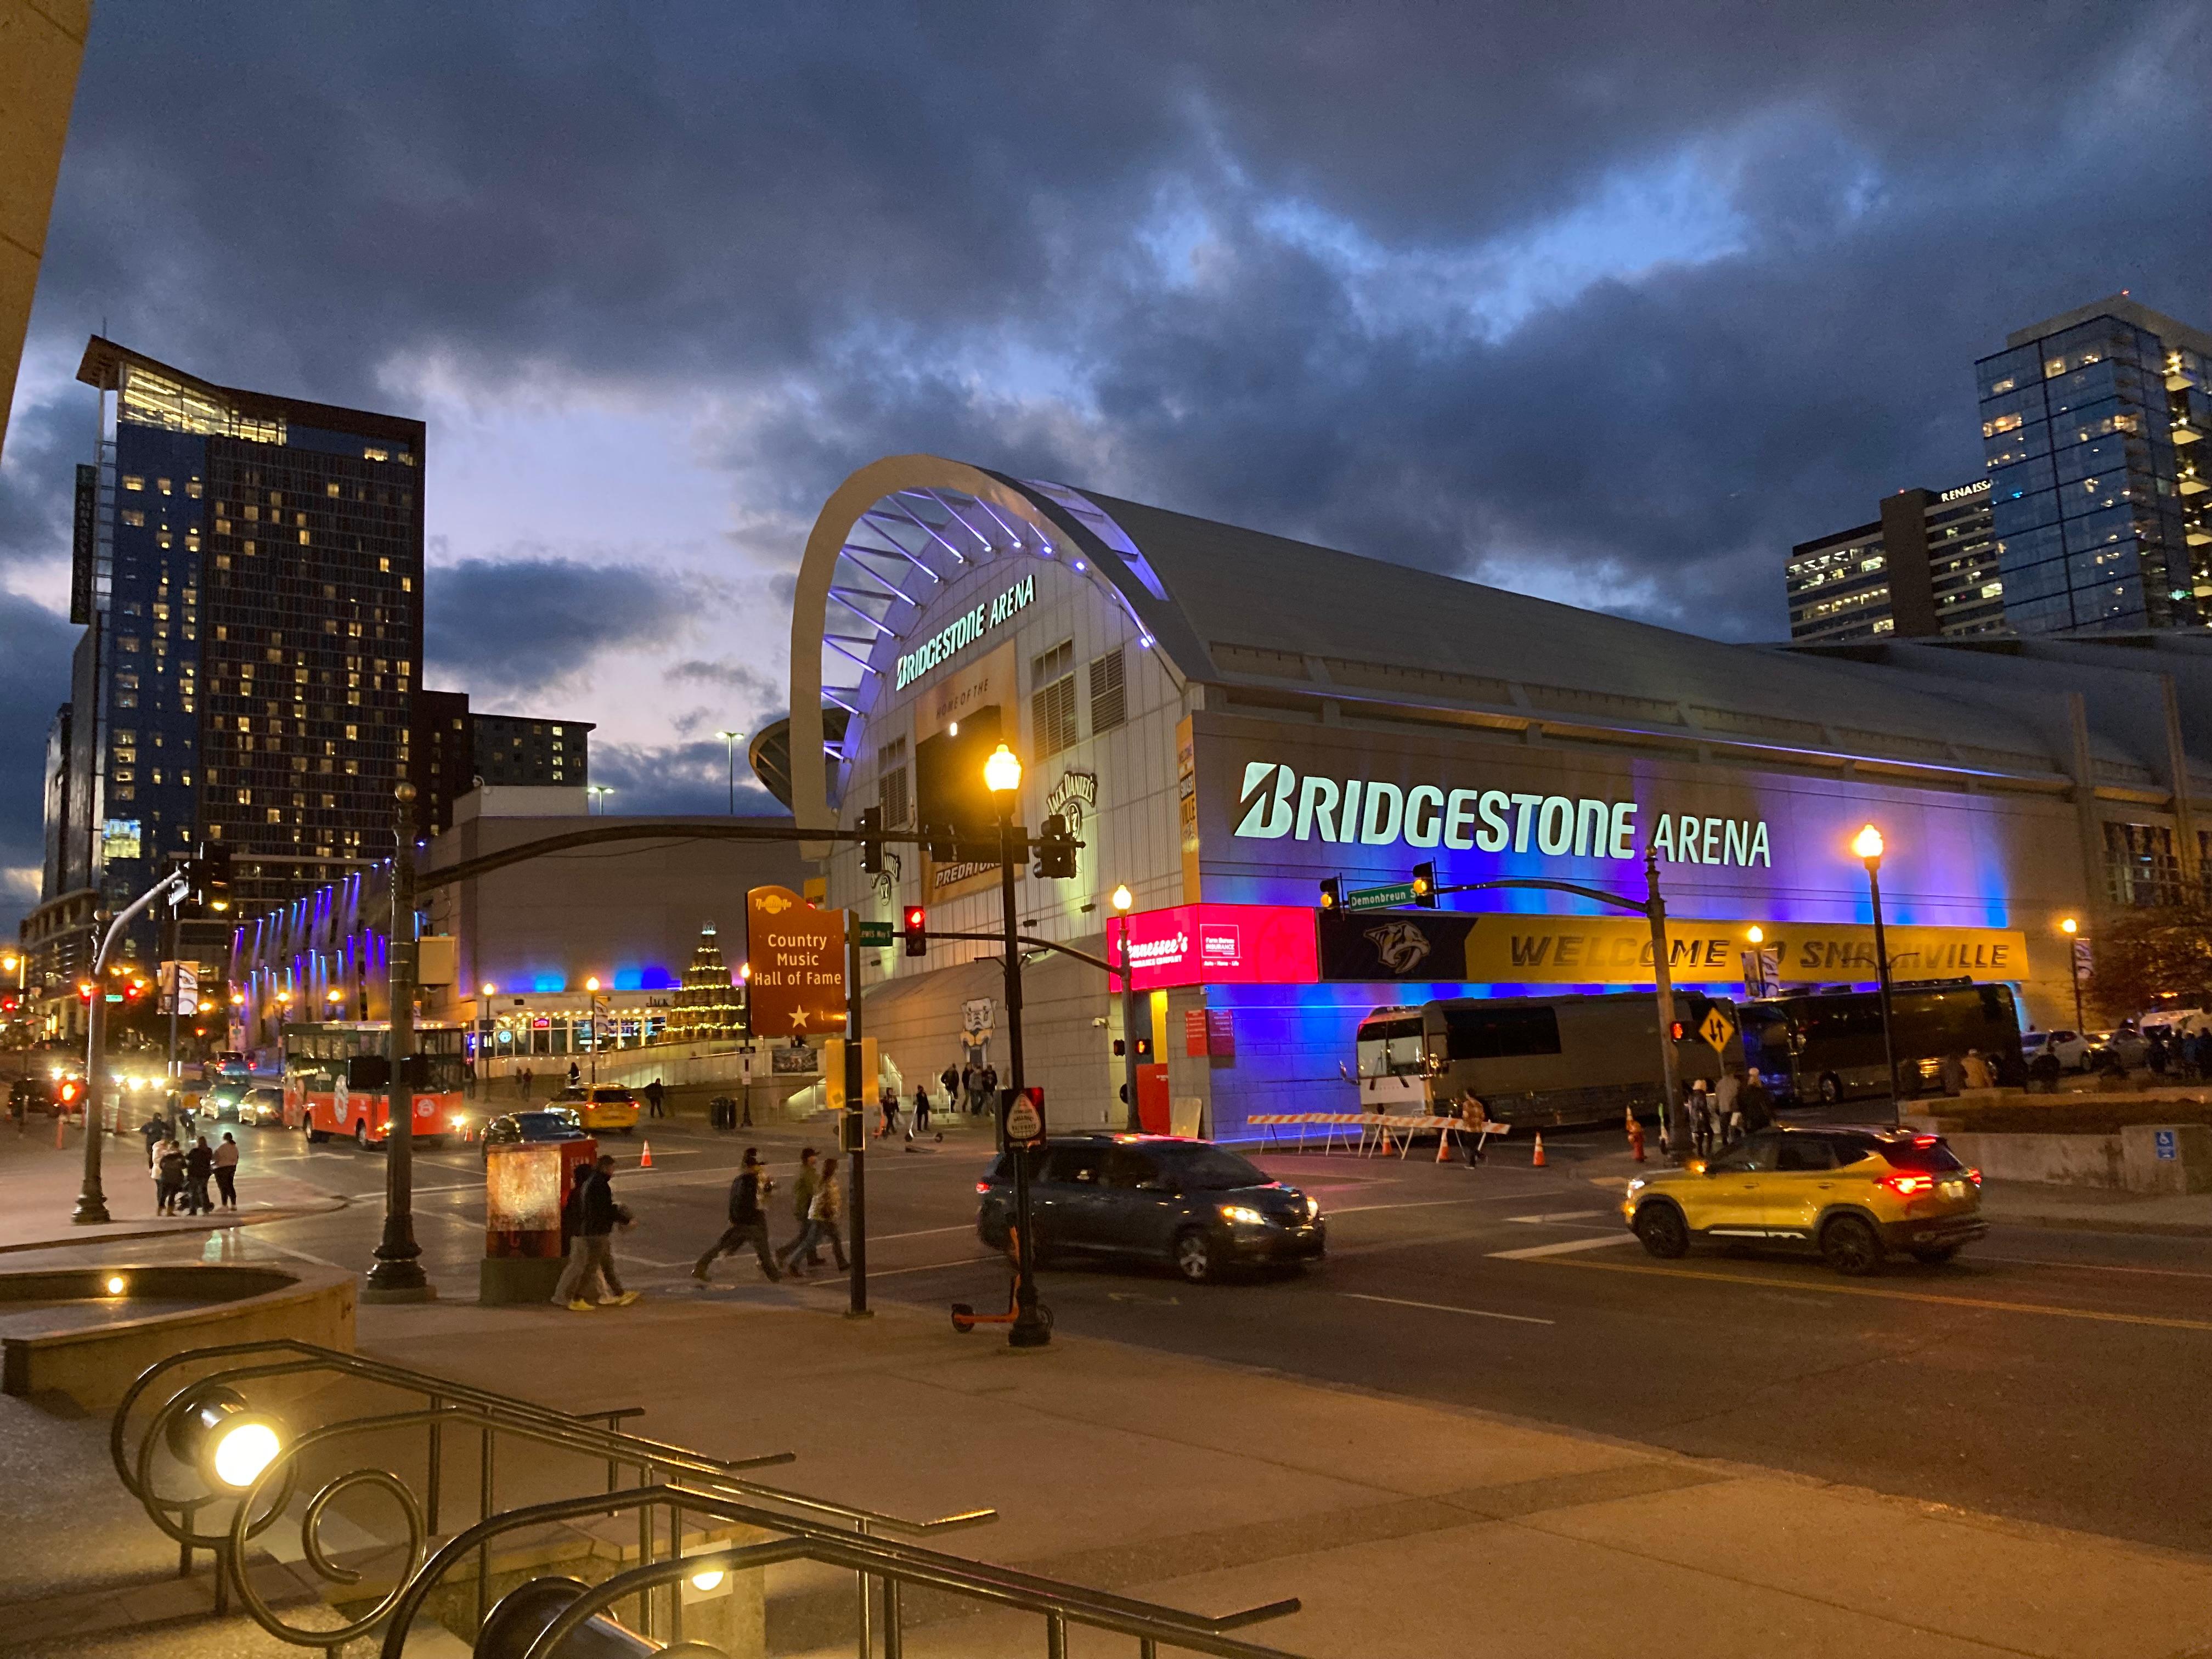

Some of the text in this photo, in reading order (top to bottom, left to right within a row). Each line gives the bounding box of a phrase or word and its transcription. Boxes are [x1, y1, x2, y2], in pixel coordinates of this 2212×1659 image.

[896, 574, 1034, 691] BRIDGESTONE ARENA
[936, 679, 988, 720] HOME OF THE
[1047, 783, 1066, 815] JACK
[1234, 761, 1771, 868] BRIDGESTONE ARENA
[935, 862, 1001, 888] PREDATO
[1351, 888, 1420, 906] Demonbreun S
[768, 934, 827, 950] Country
[777, 952, 819, 966] Music
[1130, 960, 1155, 968] SURANCE
[754, 972, 842, 986] Hall of Fame
